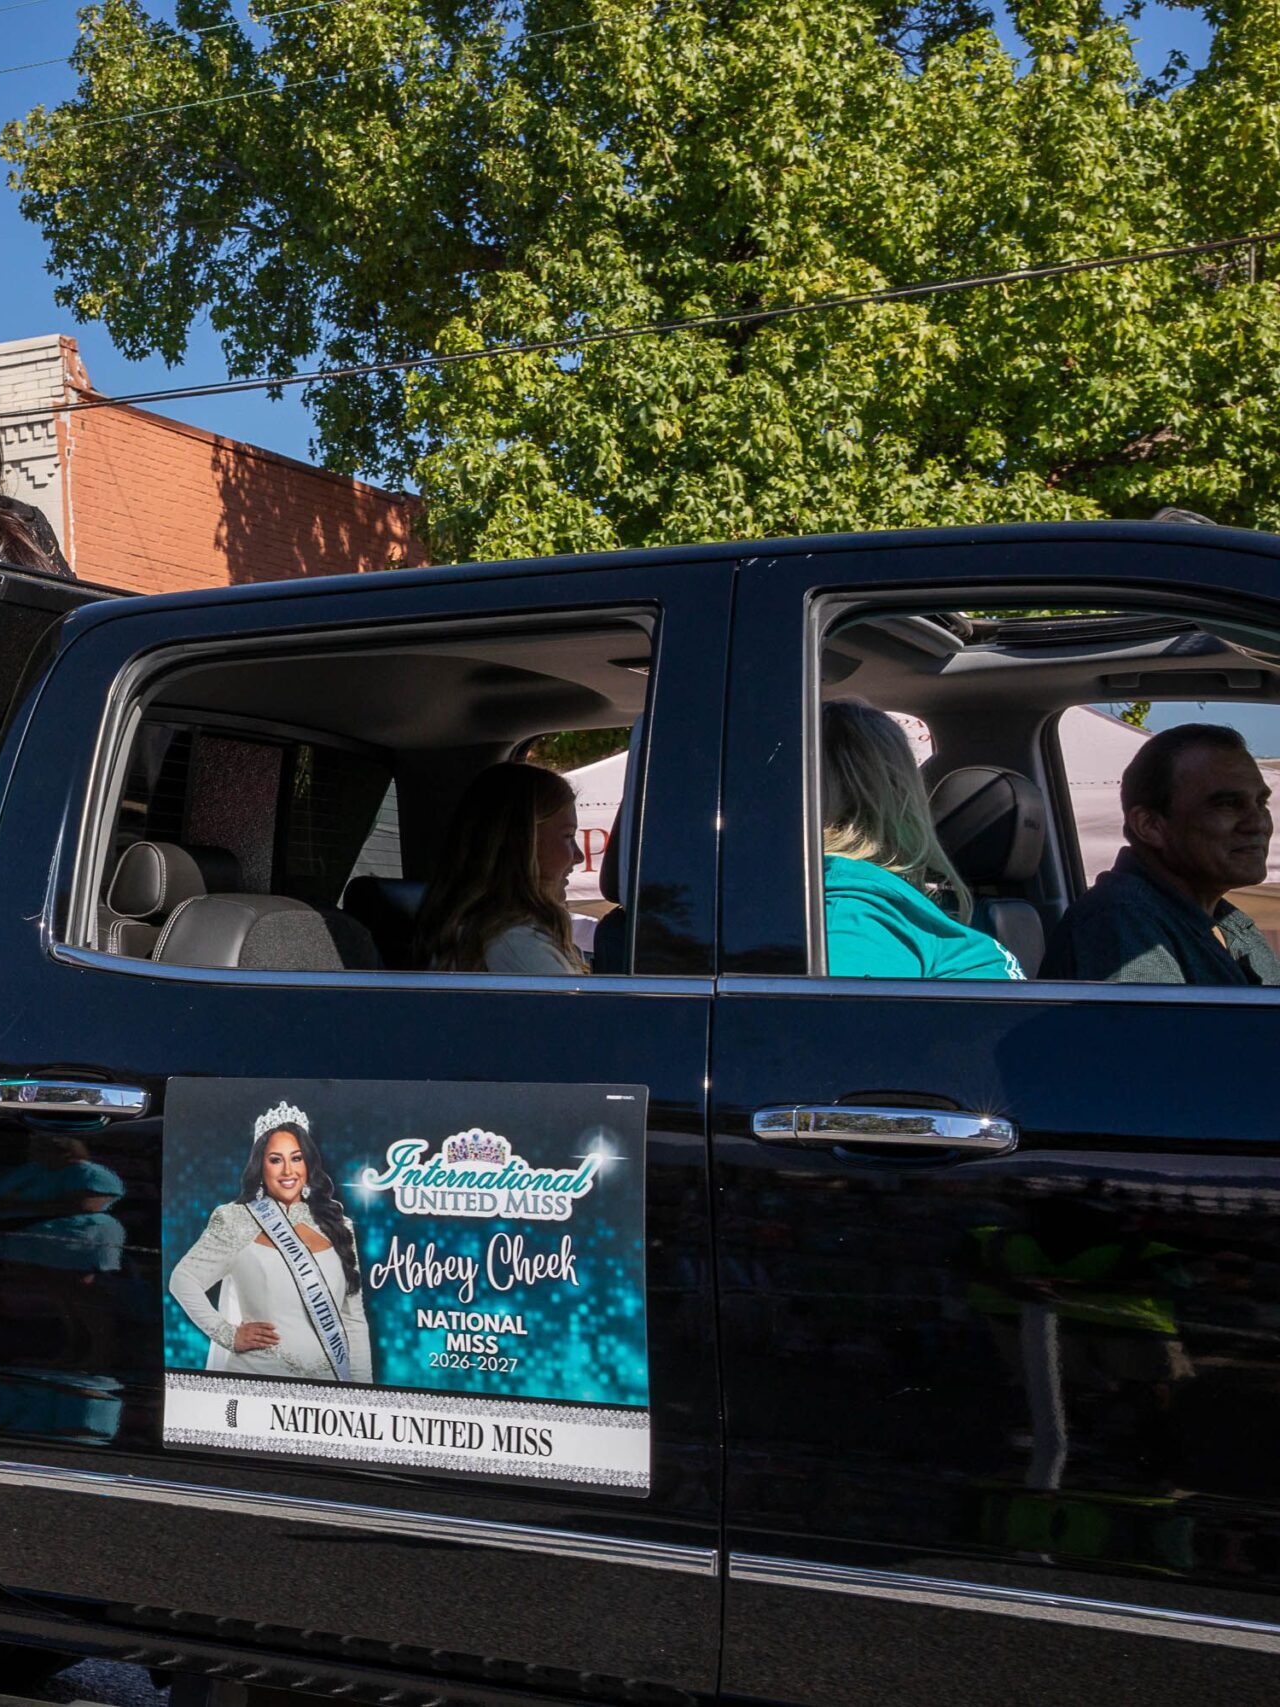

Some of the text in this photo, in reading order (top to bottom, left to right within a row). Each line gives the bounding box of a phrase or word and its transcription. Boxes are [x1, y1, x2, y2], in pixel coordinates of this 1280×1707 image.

[369, 1143, 597, 1193] International
[399, 1186, 567, 1216] UNITED MISS
[370, 1232, 580, 1304] Abbey Cheek
[270, 1221, 347, 1365] NATIONAL UNITED MISS
[417, 1309, 528, 1335] NATIONAL
[428, 1352, 518, 1373] 2026-2027
[446, 1332, 499, 1354] MISS
[270, 1404, 553, 1457] NATIONAL UNITED MISS
